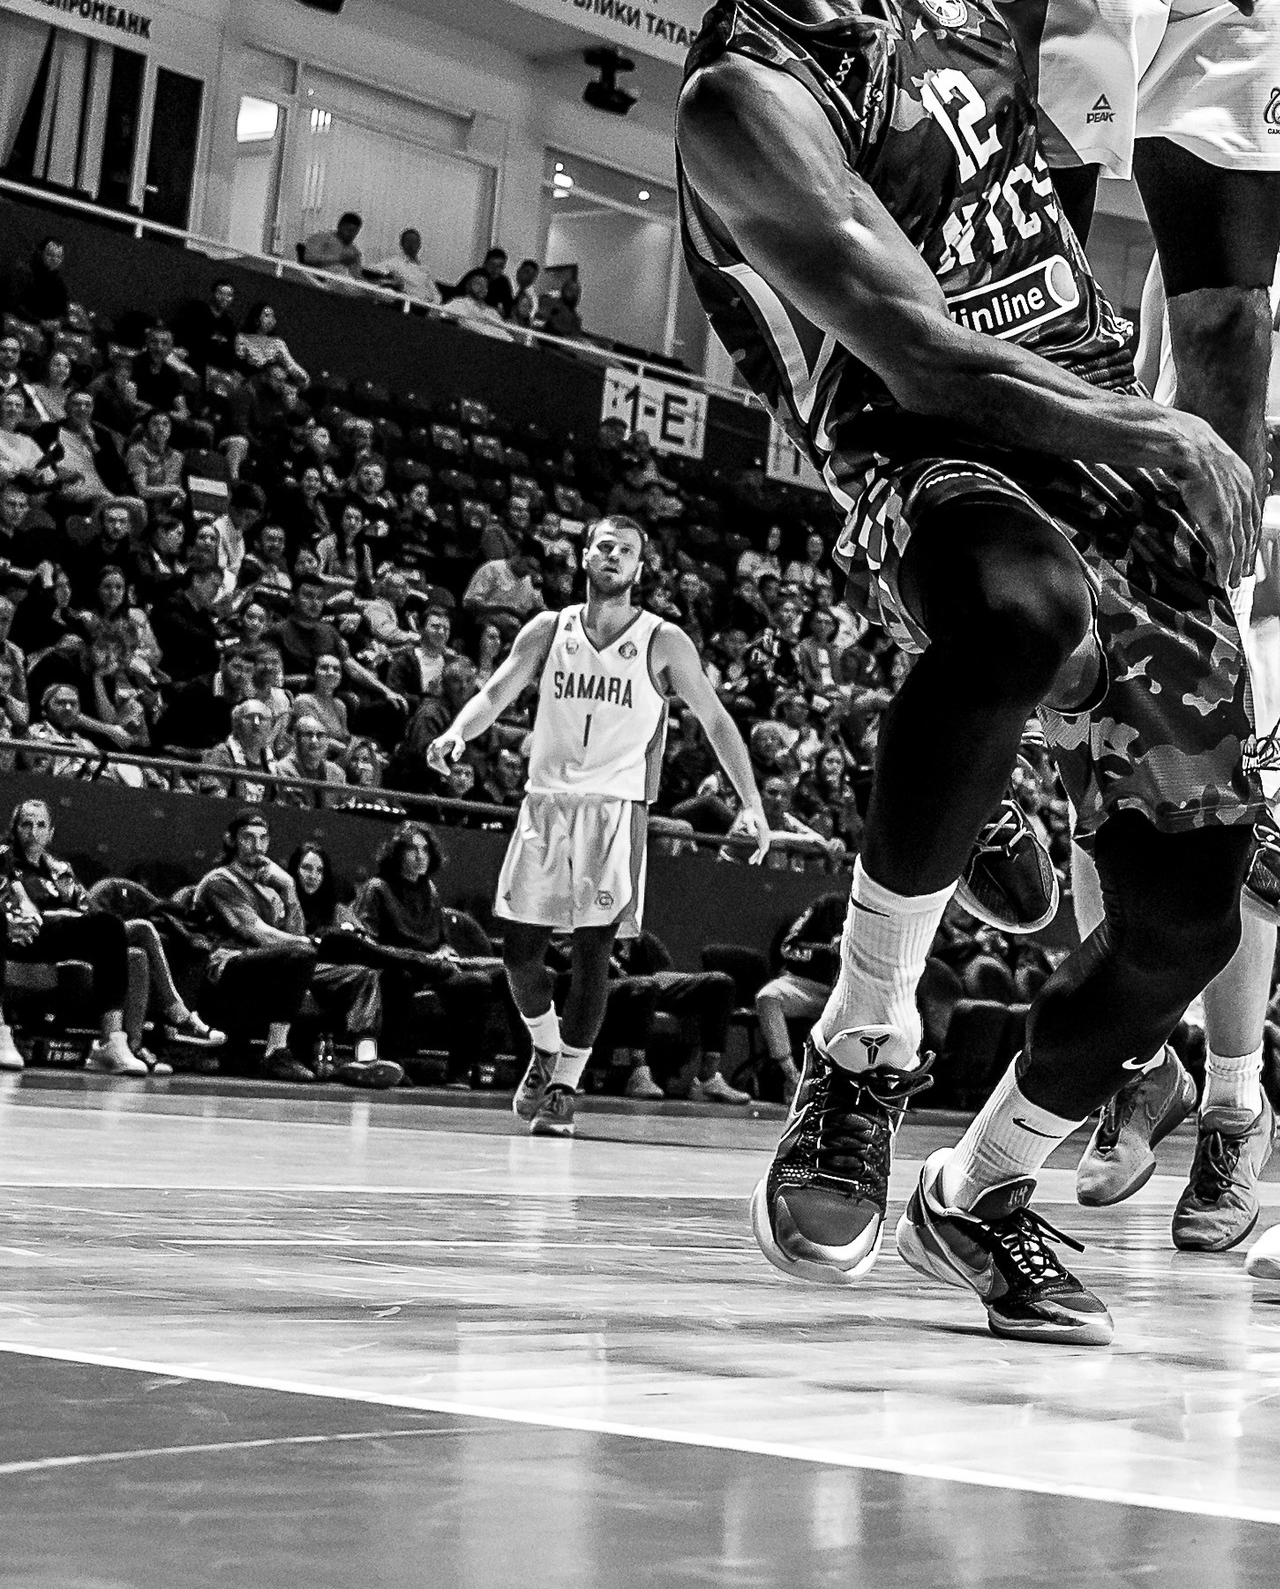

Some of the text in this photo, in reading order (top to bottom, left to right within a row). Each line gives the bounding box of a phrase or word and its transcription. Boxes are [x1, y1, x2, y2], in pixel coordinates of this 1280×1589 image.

[920, 66, 1003, 184] 12
[1085, 113, 1117, 124] PEAK
[554, 671, 633, 709] SAMARA
[583, 714, 592, 748] 1
